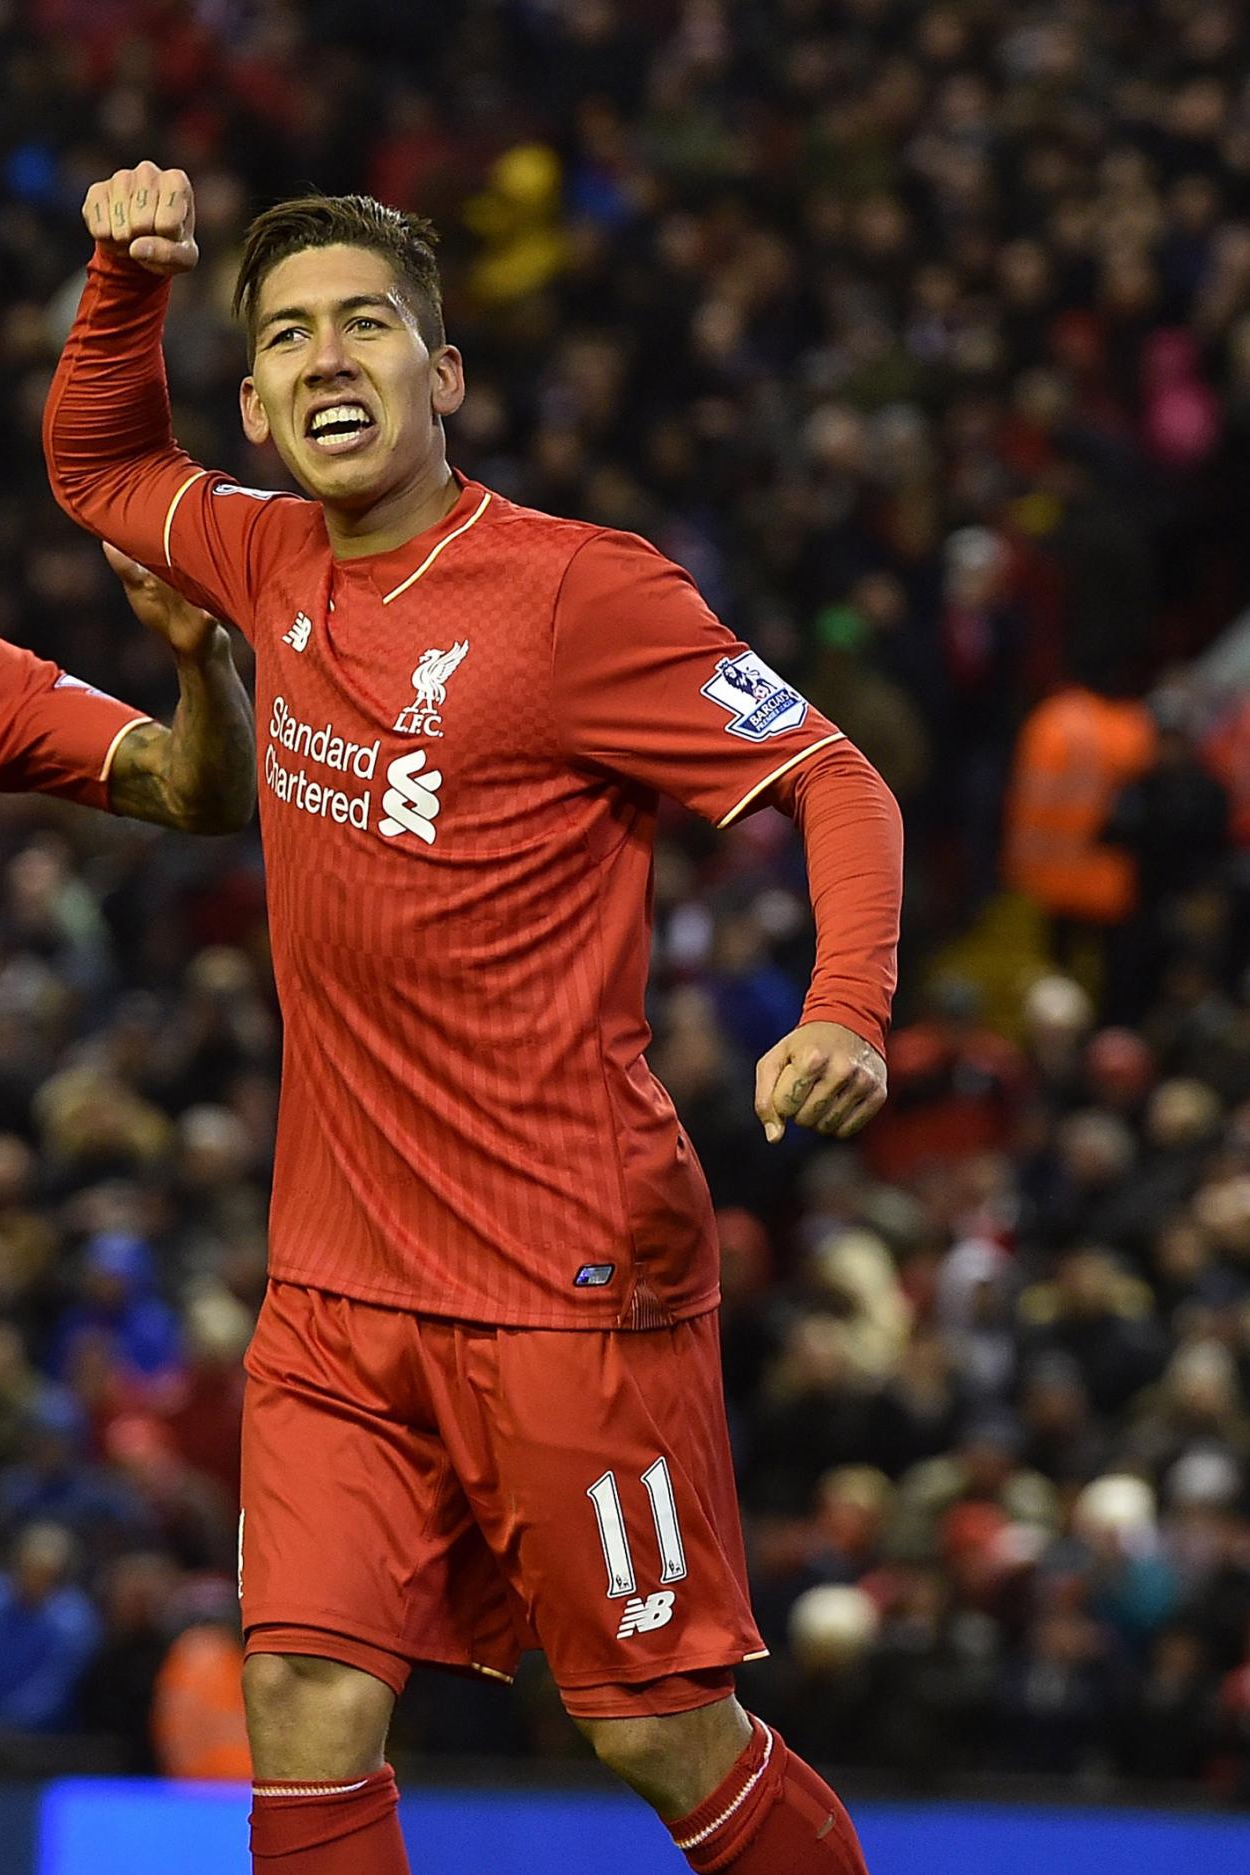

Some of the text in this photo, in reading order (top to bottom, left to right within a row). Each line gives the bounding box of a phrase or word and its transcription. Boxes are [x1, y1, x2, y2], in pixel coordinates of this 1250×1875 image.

[269, 696, 381, 781] Standard
[749, 690, 790, 727] BARCLAYS
[265, 744, 371, 831] Chartered
[586, 1455, 688, 1599] 11
